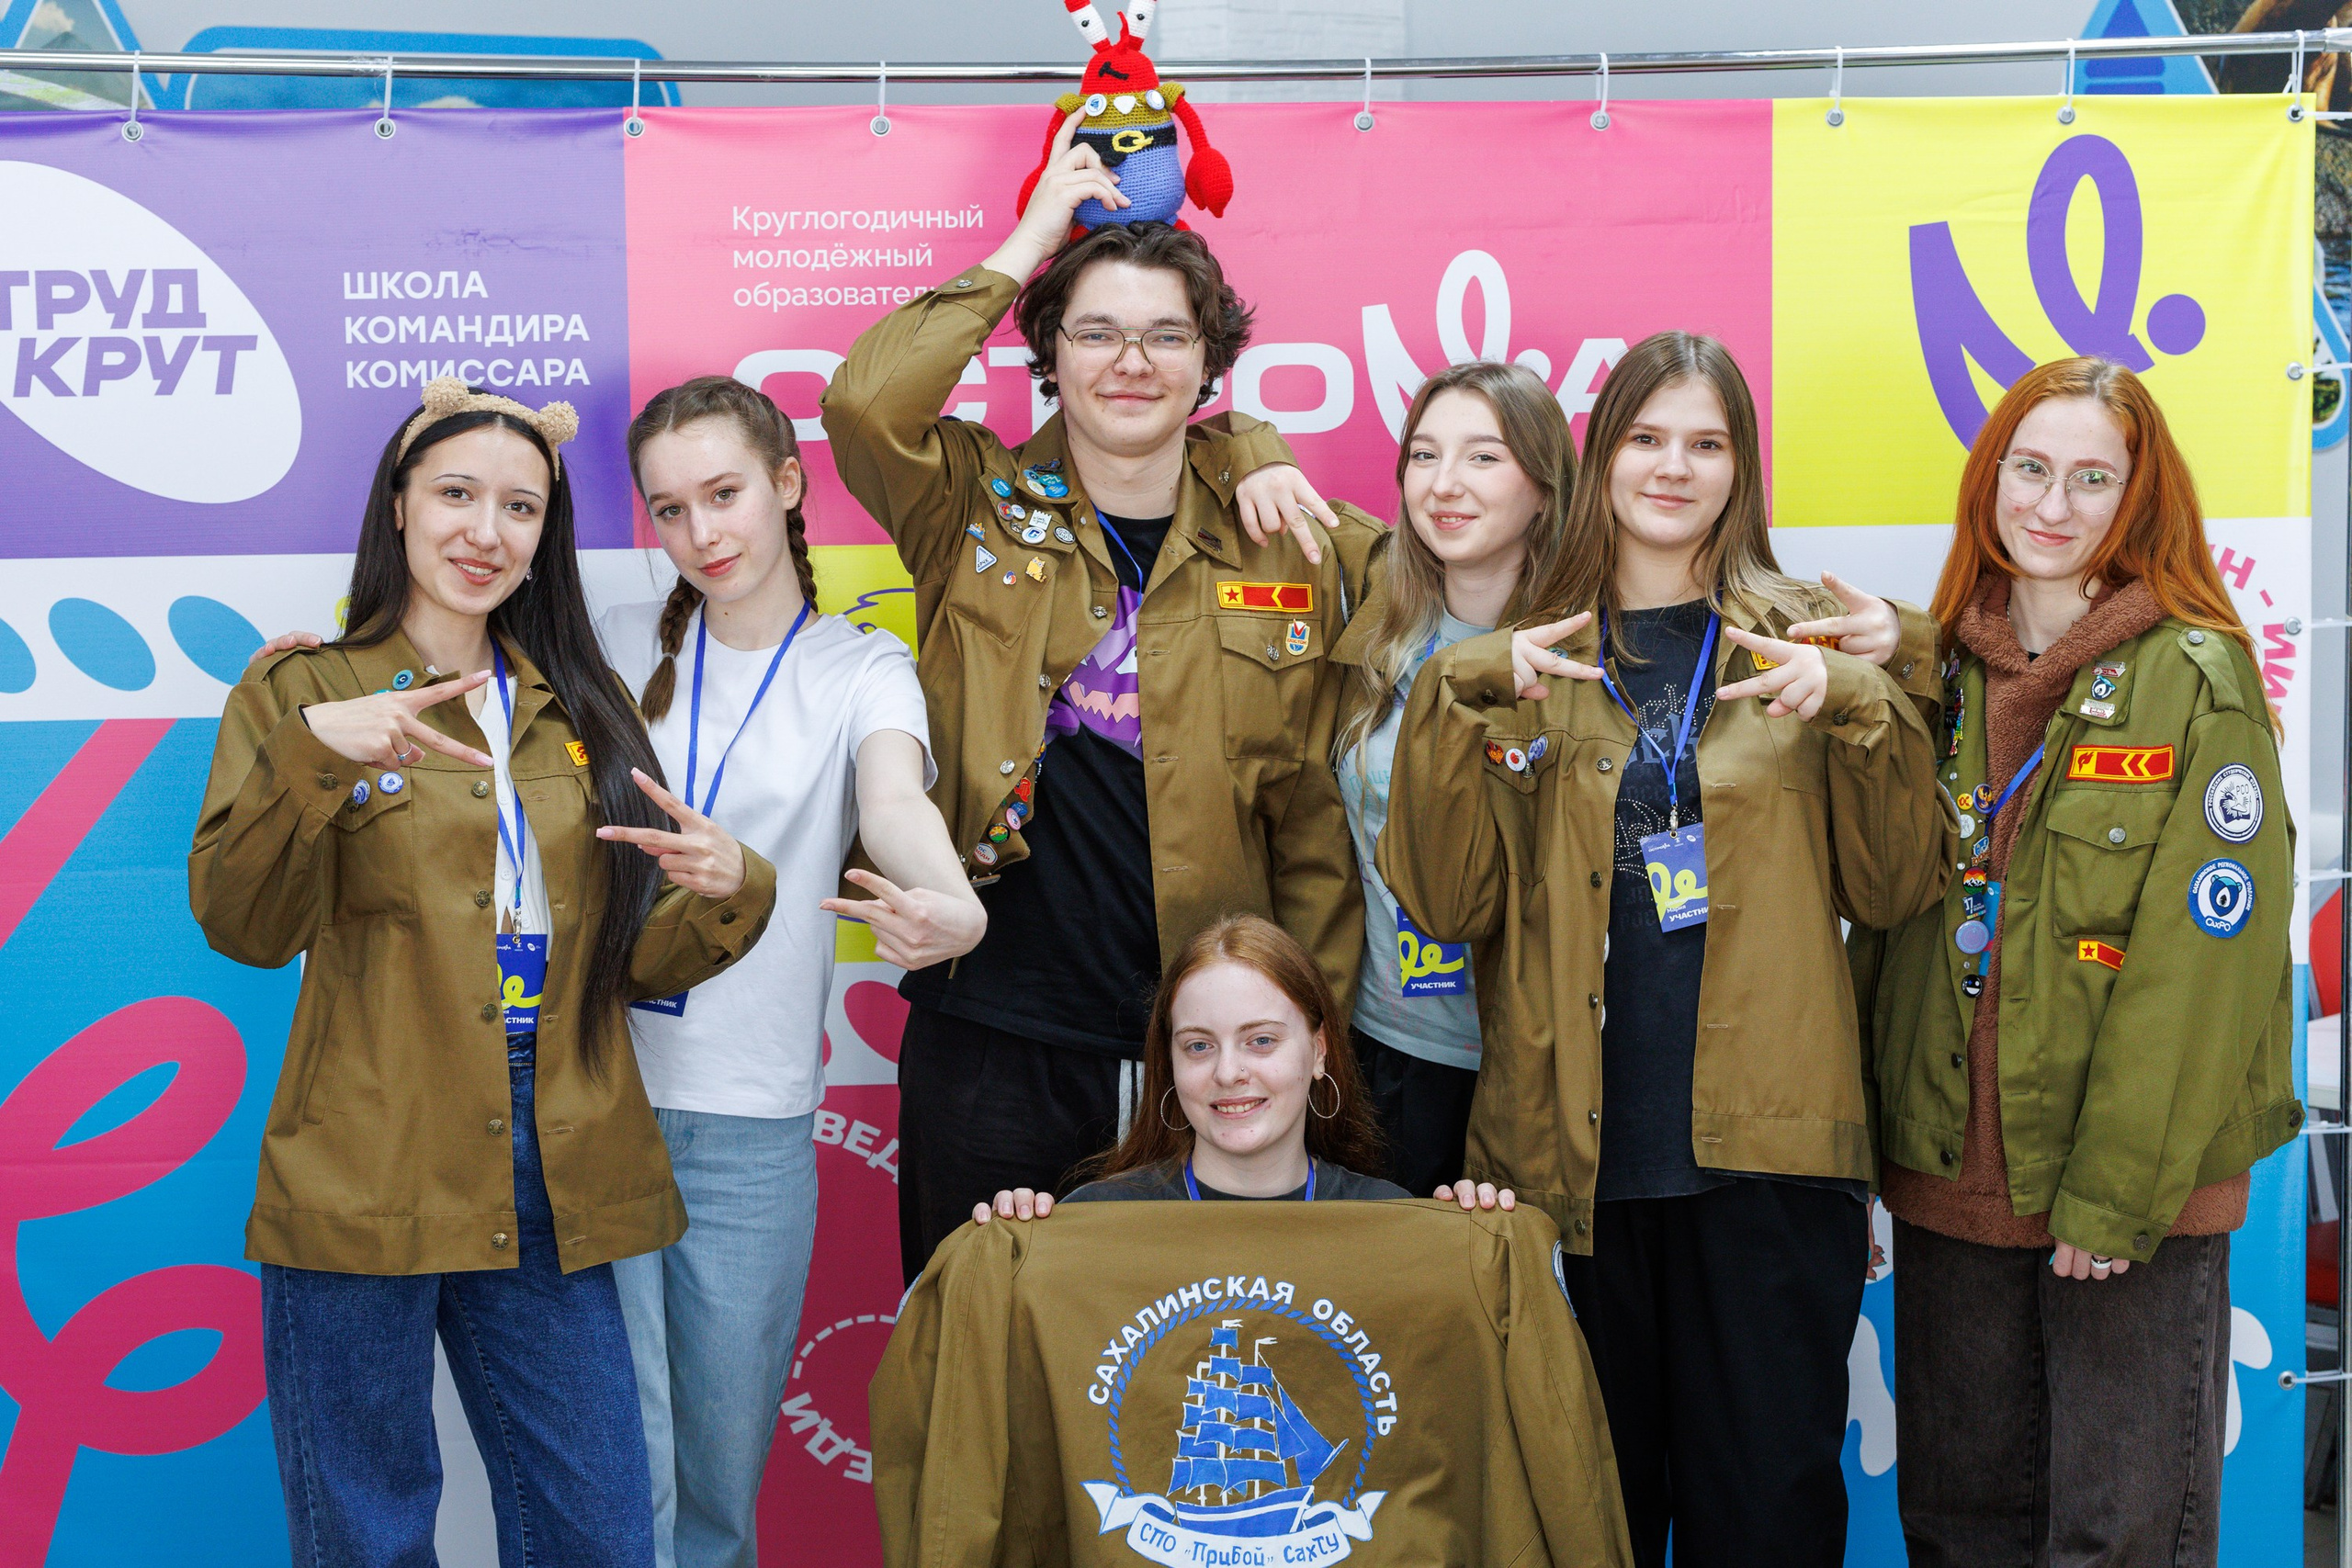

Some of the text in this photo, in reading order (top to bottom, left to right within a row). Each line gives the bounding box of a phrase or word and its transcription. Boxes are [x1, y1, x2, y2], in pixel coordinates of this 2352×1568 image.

[732, 204, 984, 237] Круглогодичный
[733, 243, 933, 271] молодёжный
[344, 271, 489, 299] ШКОЛА
[345, 313, 591, 348] КОМАНДИРА
[13, 334, 258, 398] КРУТ
[346, 357, 592, 389] КОМИССАРА
[1410, 981, 1456, 990] УЧАСТНИК
[1088, 1275, 1398, 1438] САХАЛИНСКАЯ ОБЛАСТЬ
[1139, 1522, 1178, 1553] СПО
